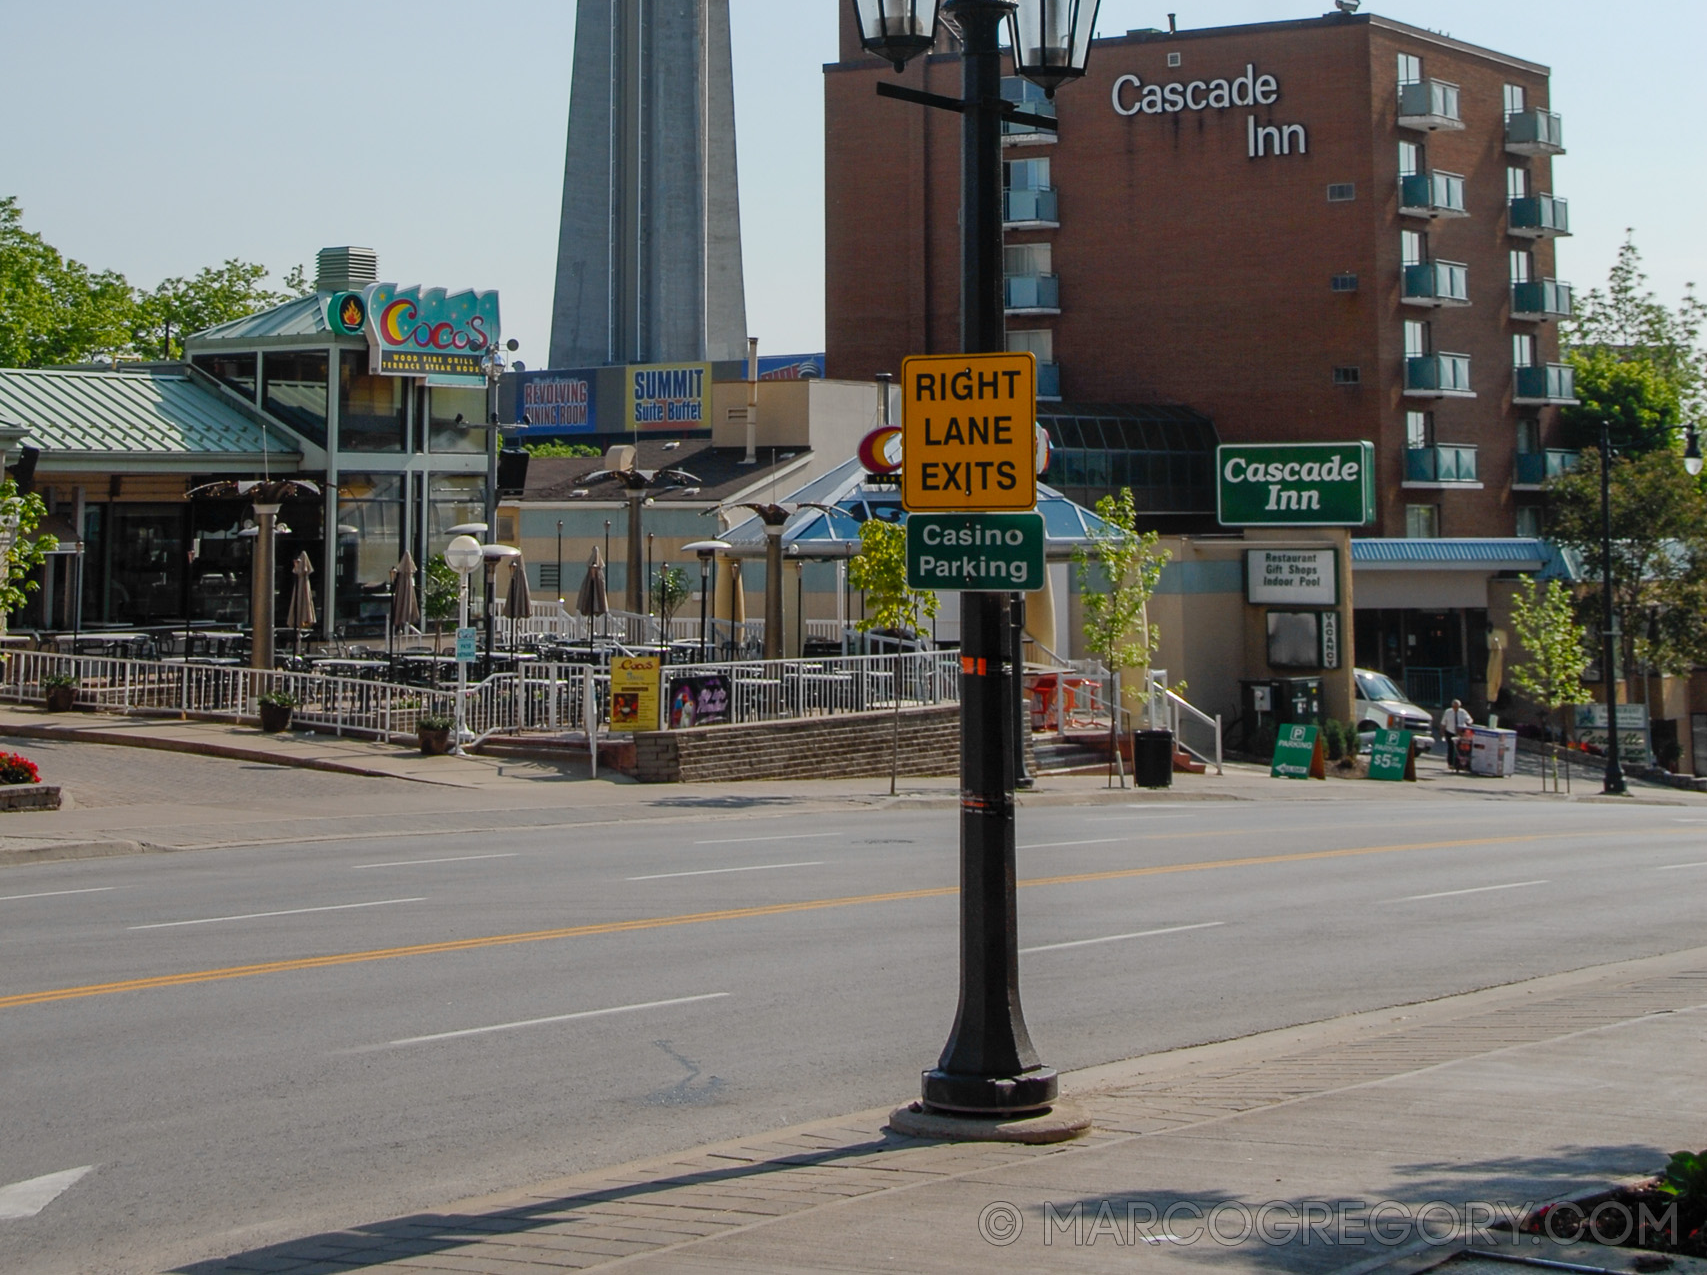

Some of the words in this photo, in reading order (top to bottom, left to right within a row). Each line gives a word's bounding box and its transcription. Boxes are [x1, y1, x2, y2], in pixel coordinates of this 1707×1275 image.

[1111, 63, 1278, 116] Cascade
[1248, 115, 1306, 157] Inn
[382, 361, 420, 371] TERRACE
[425, 362, 452, 372] STEAK
[456, 364, 480, 373] HOUS
[393, 354, 418, 363] WOOD
[423, 355, 443, 364] FIRE
[447, 356, 474, 365] GRILL
[524, 381, 588, 405] REVOLVING
[634, 368, 704, 401] SUMMIT
[916, 370, 1022, 402] RIGHT
[559, 405, 588, 425] ROOM
[634, 402, 664, 423] Suite
[667, 400, 703, 422] Buffet
[924, 415, 1013, 446] LANE
[921, 460, 1017, 491] EXITS
[1223, 454, 1359, 483] Cascade
[1264, 484, 1321, 511] Inn
[922, 524, 1024, 546] Casino
[1265, 552, 1317, 563] Restaurant
[919, 555, 1028, 583] Parking
[1265, 564, 1283, 575] Gift
[1288, 564, 1318, 576] Shops
[1263, 576, 1294, 586] Indoor
[1299, 576, 1320, 586] Pool
[1325, 613, 1335, 667] VACANCY
[1278, 739, 1313, 750] PARKING
[1293, 728, 1303, 739] P
[1388, 733, 1397, 743] P
[1374, 743, 1407, 754] PARKING
[1374, 753, 1392, 769] $5
